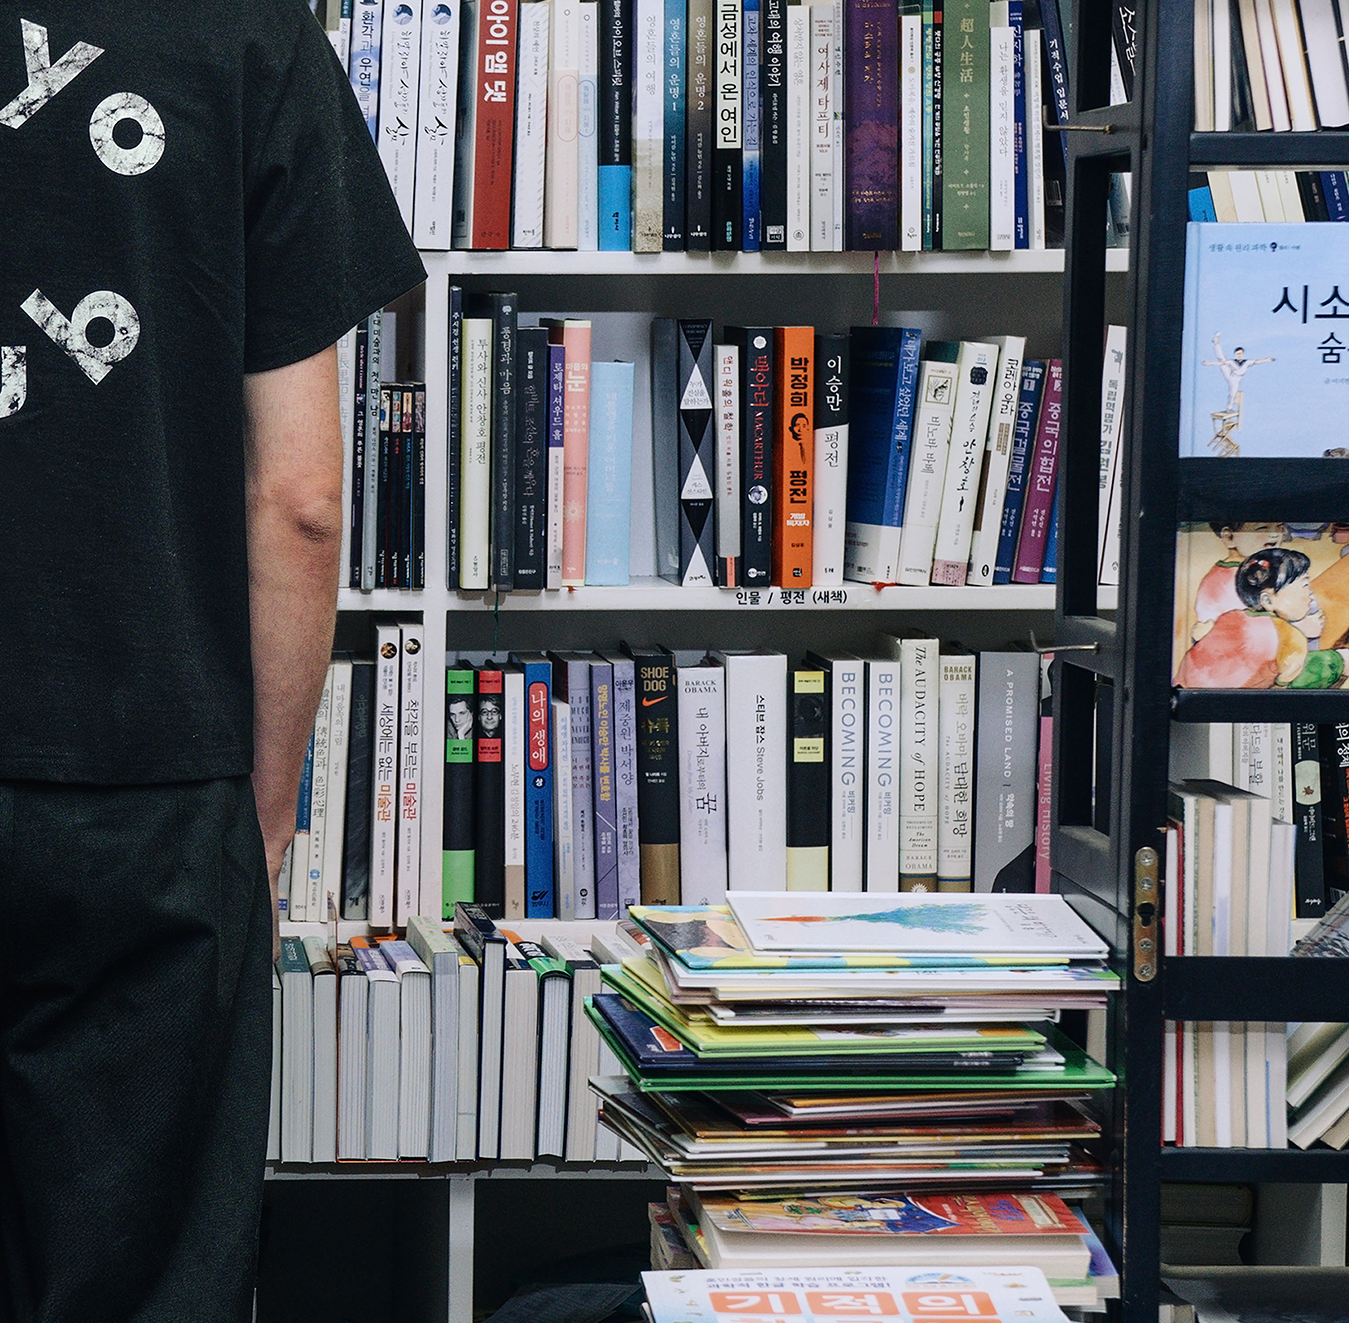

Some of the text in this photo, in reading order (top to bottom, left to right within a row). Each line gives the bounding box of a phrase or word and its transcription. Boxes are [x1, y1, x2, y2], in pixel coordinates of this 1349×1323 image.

[486, 0, 509, 46] 아이
[767, 0, 781, 87] 고대의 여행 이야기
[960, 17, 975, 84] 超人生活
[483, 80, 507, 103] 댓
[485, 52, 508, 74] 앰
[669, 18, 680, 111] 영혼들의 운명 1
[696, 16, 706, 111] 영혼들의 운명 2
[720, 3, 738, 143] 금성에서 온 여인
[476, 339, 488, 465] 투사와 신사 안창호 평전
[500, 369, 512, 395] 마음
[824, 355, 843, 468] 이승만 평전
[789, 357, 810, 504] 박정희 평전
[736, 591, 762, 605] 인물
[780, 591, 806, 605] 평전
[812, 590, 848, 605] (새책)
[640, 666, 669, 679] SHOE
[644, 680, 666, 692] DOG
[943, 666, 972, 674] BARACK
[531, 690, 547, 765] 나의 생애
[696, 707, 709, 718] 내
[841, 672, 856, 787] BECOMING
[877, 673, 893, 788] BECOMING
[913, 646, 927, 813] The AUDACITY of HOPE
[955, 721, 968, 758] 오바마
[1005, 681, 1014, 740] PROMISED
[377, 703, 393, 822] 세상에는 없는 미술관
[403, 699, 418, 821] 착각을 부르는 미술관
[755, 694, 766, 802] 스티브 잡스 Steve Jobs
[1004, 746, 1013, 779] LAND
[696, 792, 717, 815] 꿈
[953, 763, 969, 806] 담대한
[952, 809, 968, 838] 희망
[726, 1293, 990, 1315] 기적의
